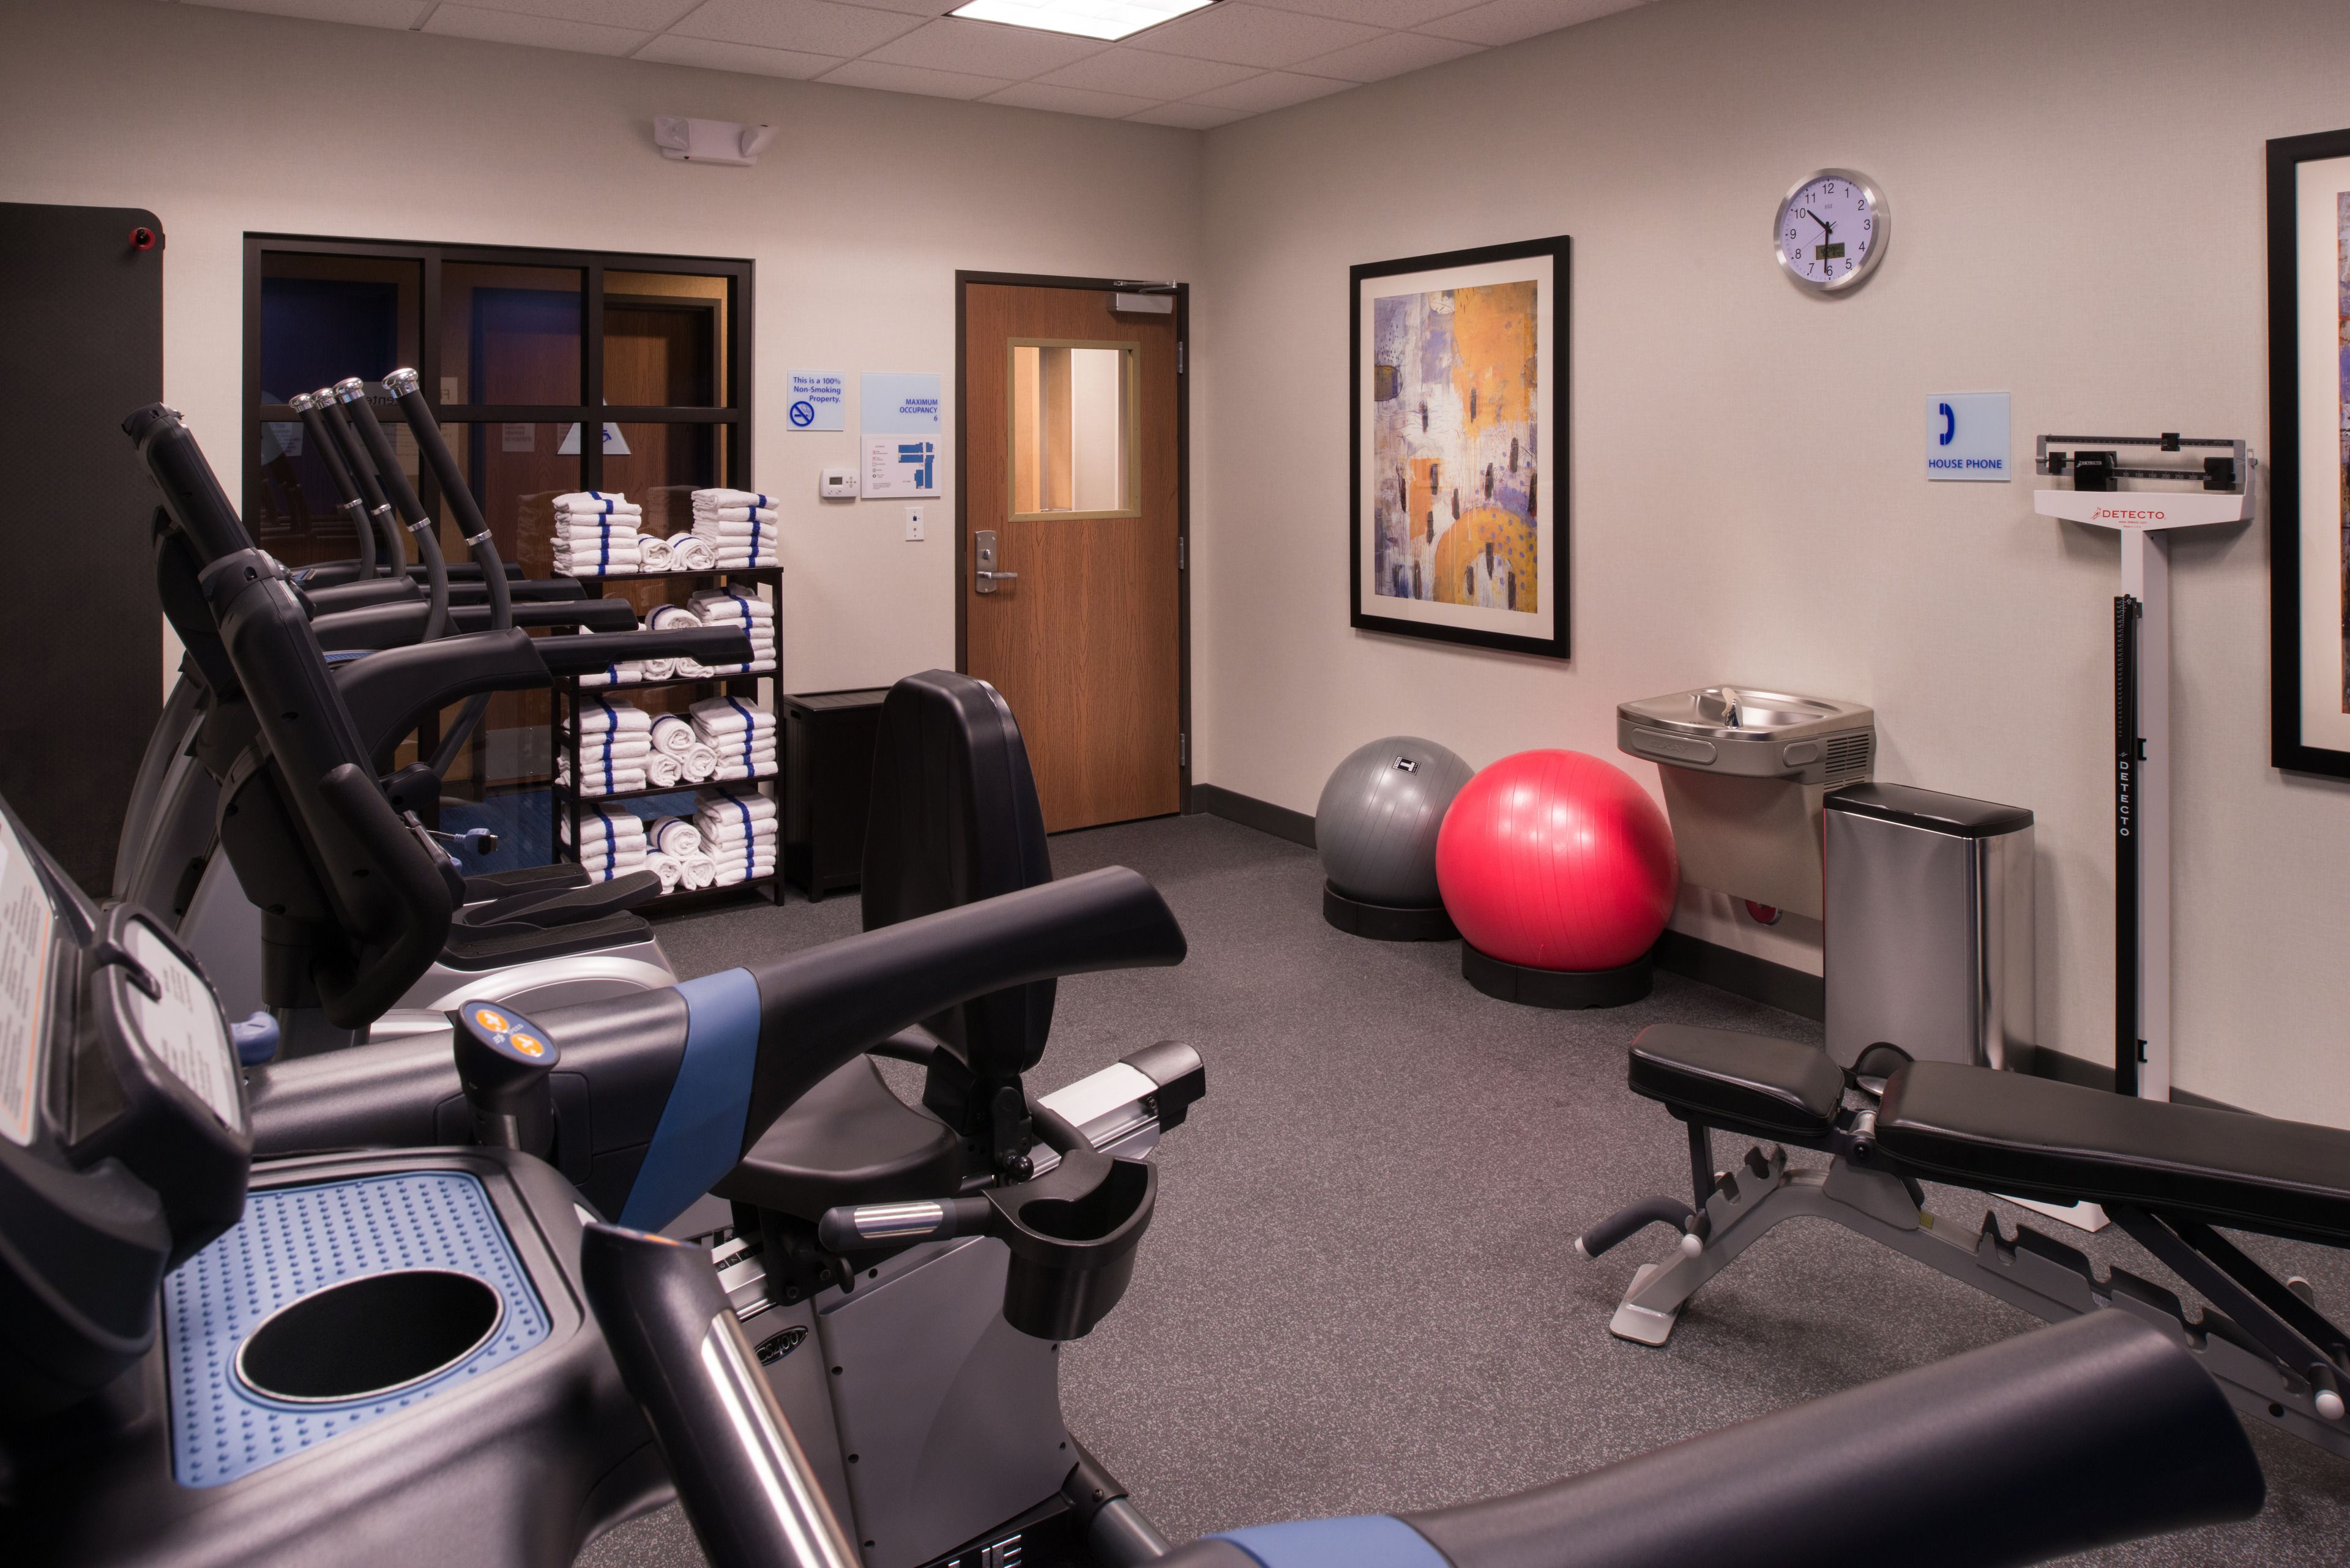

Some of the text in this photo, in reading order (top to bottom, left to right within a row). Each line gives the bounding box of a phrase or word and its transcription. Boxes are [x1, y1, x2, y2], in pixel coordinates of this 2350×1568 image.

[1822, 183, 1833, 194] 12
[1845, 188, 1849, 198] 1
[1805, 193, 1816, 204] 11
[1858, 200, 1864, 211] 2
[1794, 208, 1805, 218] 10
[1863, 219, 1870, 230] 3
[1790, 229, 1796, 239] 9
[1859, 241, 1865, 252] 4
[1795, 248, 1801, 259] 8
[1808, 263, 1815, 274] 7
[1845, 259, 1852, 269] 5
[1826, 266, 1833, 276] 6
[794, 386, 841, 394] Non-Smoking
[1929, 459, 2002, 469] HOUSE PHONE
[2102, 510, 2165, 519] DETECTO
[1649, 739, 1689, 753] ELKAY
[1400, 762, 1416, 772] T
[2119, 761, 2130, 837] DETECTO
[756, 1331, 799, 1362] CS400
